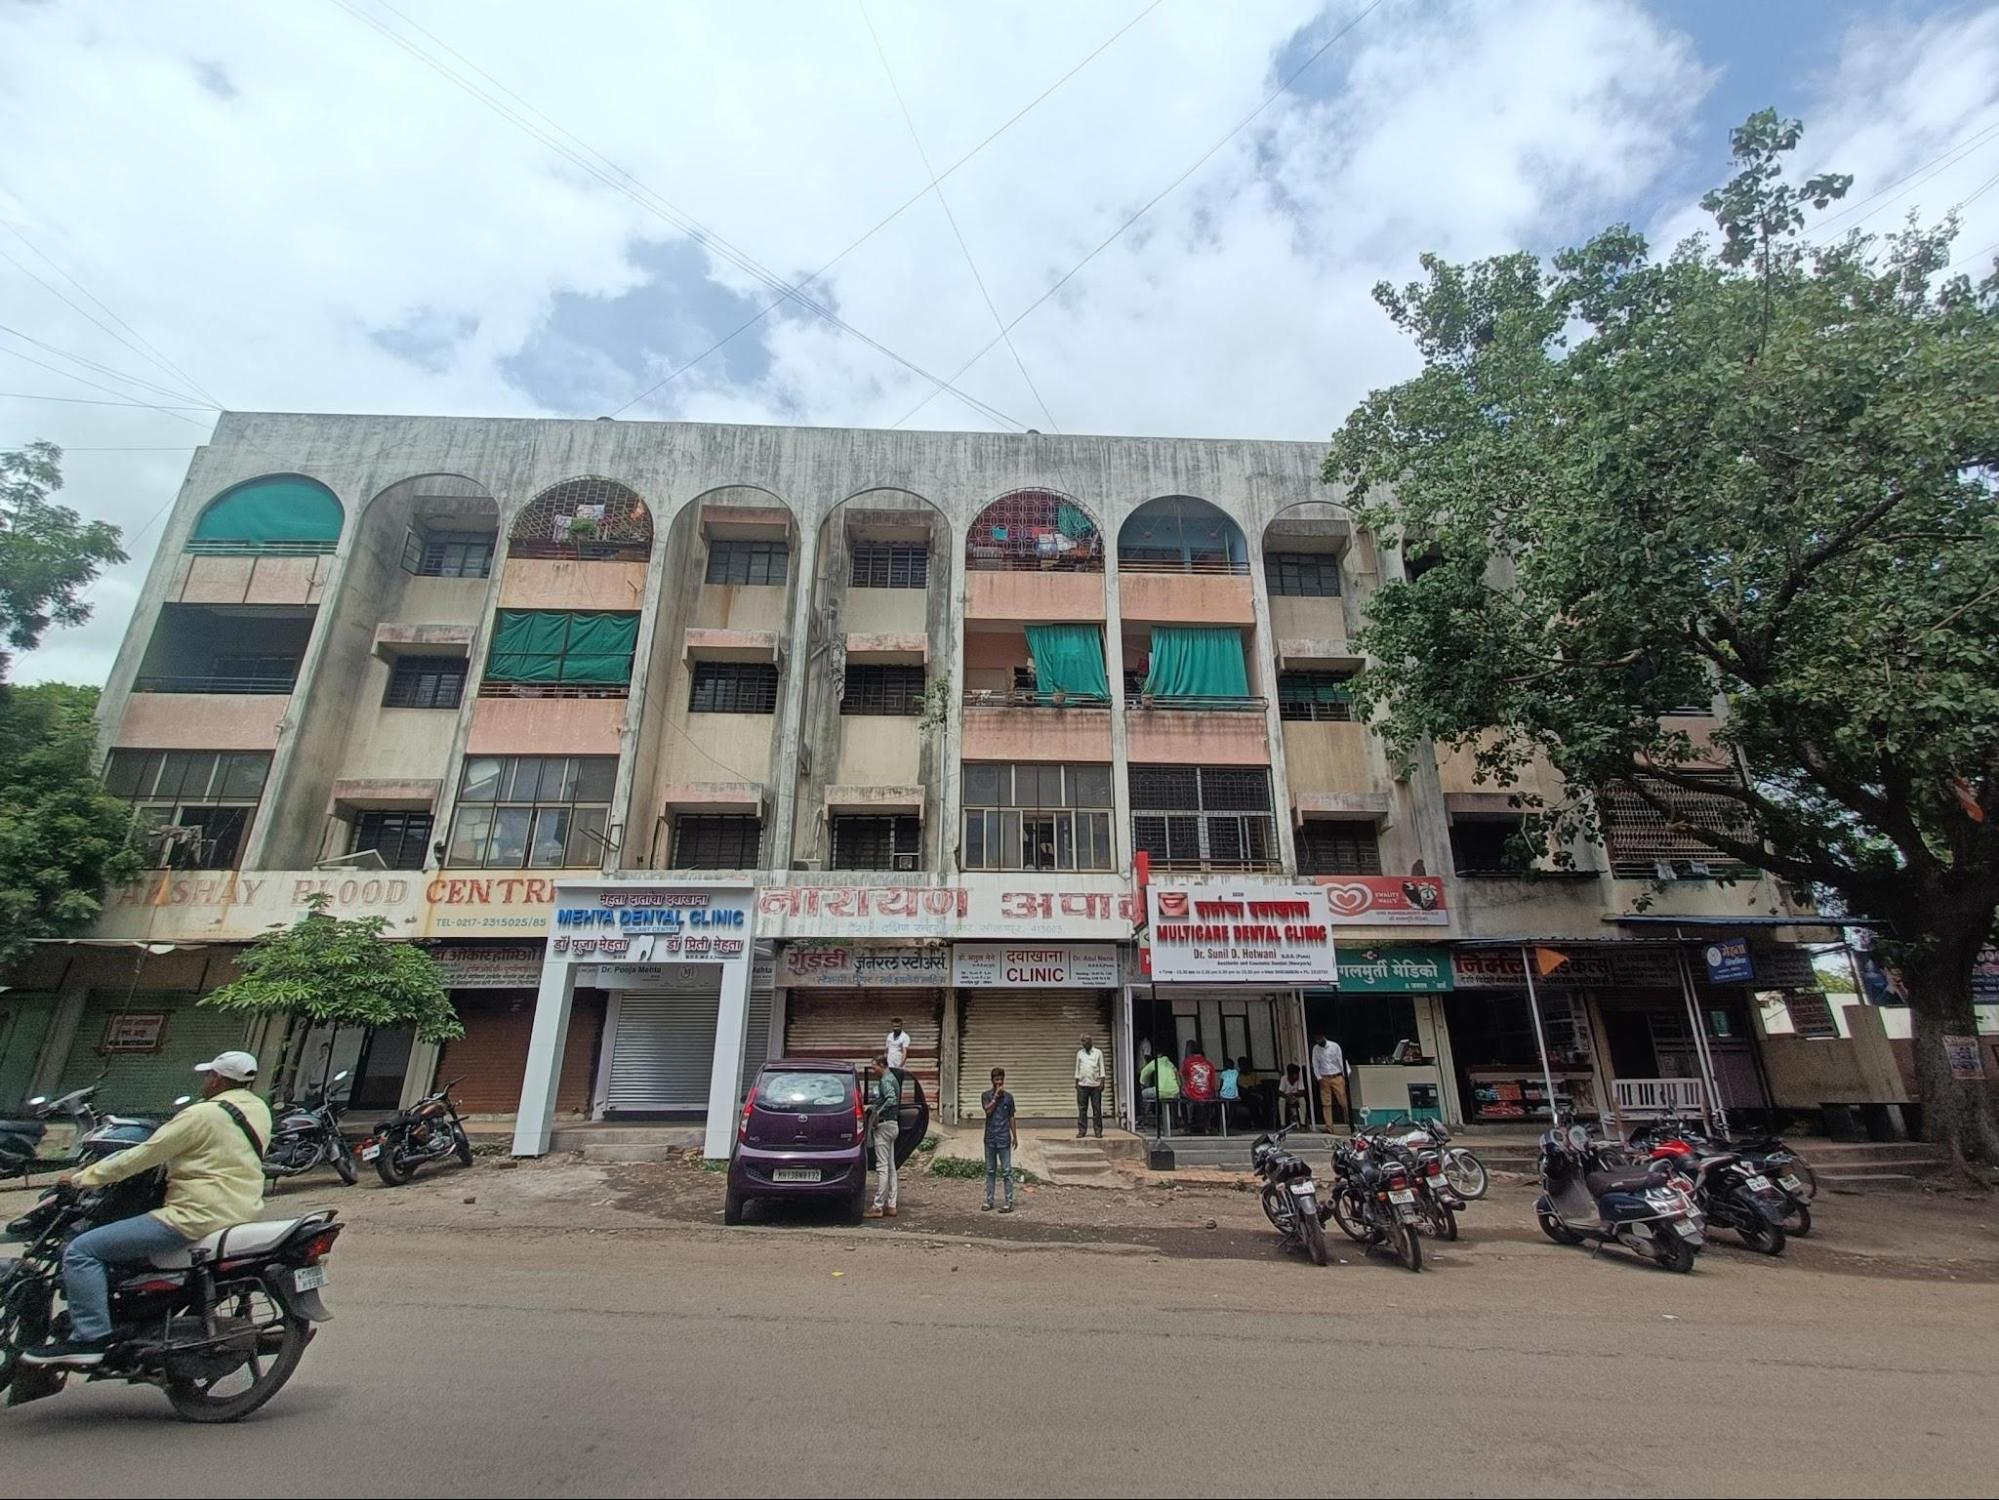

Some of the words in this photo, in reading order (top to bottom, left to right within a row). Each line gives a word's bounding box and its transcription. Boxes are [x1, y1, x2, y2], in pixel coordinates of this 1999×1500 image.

[426, 879, 554, 904] CENTR
[665, 894, 710, 906] दवाखाना
[759, 886, 970, 919] नारायण
[557, 909, 615, 927] MEHTA
[619, 909, 685, 927] DENTAL
[689, 909, 745, 927] CLINIC
[1156, 925, 1230, 941] MULTICARE
[1233, 925, 1282, 941] DENTAL
[1285, 925, 1327, 941] CLINIC
[572, 939, 597, 956] पूजा
[599, 936, 629, 951] मेहता
[714, 936, 743, 952] मेहता
[1007, 950, 1064, 963] दवाखाना
[1194, 949, 1205, 959] Dr.
[1207, 949, 1229, 959] Sunil
[1242, 949, 1277, 959] Hotwani
[601, 966, 613, 974] Dr.
[614, 966, 637, 975] Pooja
[638, 966, 662, 974] Mehta
[1006, 967, 1064, 982] CLINIC
[1336, 959, 1387, 984] गलमुर्ती
[1391, 959, 1439, 978] मेडिको
